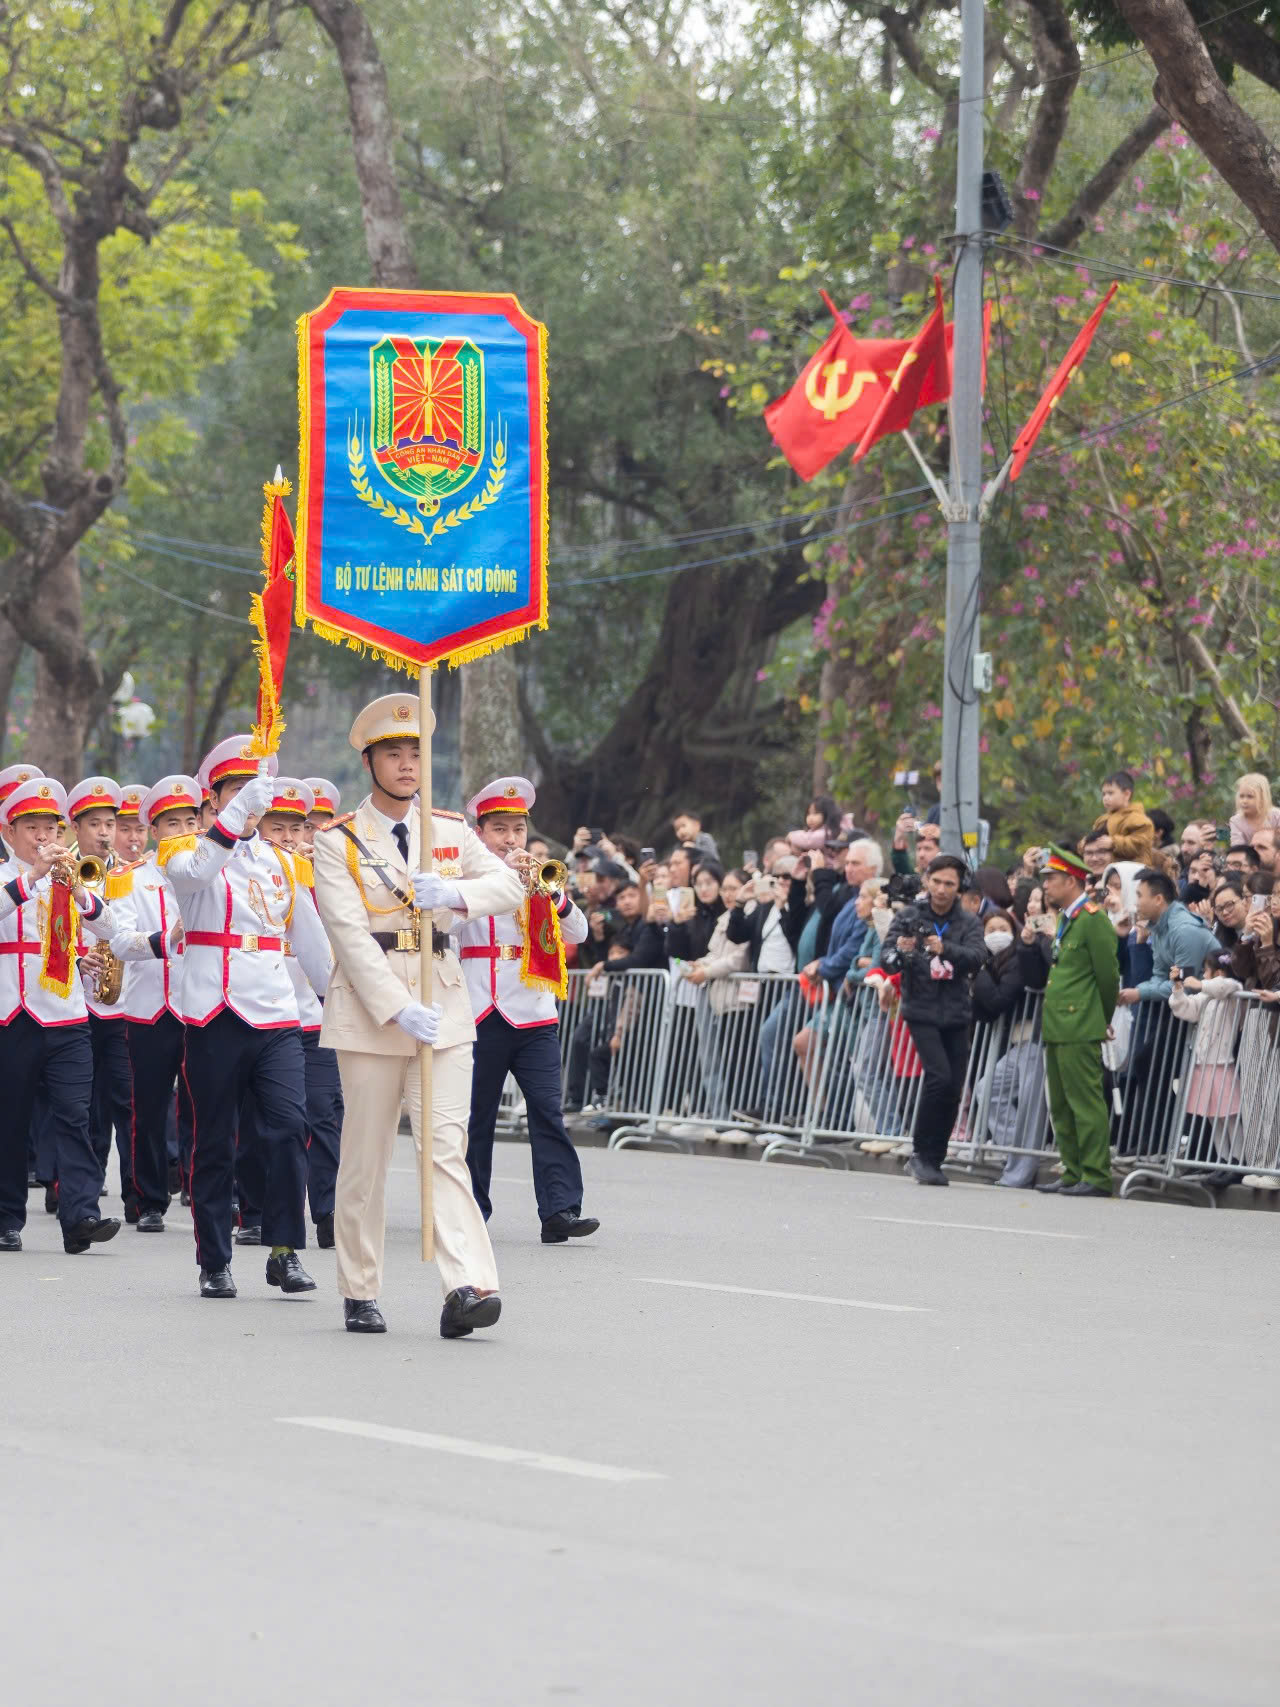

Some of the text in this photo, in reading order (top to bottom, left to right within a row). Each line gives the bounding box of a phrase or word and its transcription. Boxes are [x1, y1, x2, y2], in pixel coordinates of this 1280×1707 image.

[335, 559, 518, 598] BỘ TƯ LỆNH CẢNH SÁT CƠ ĐỘNG
